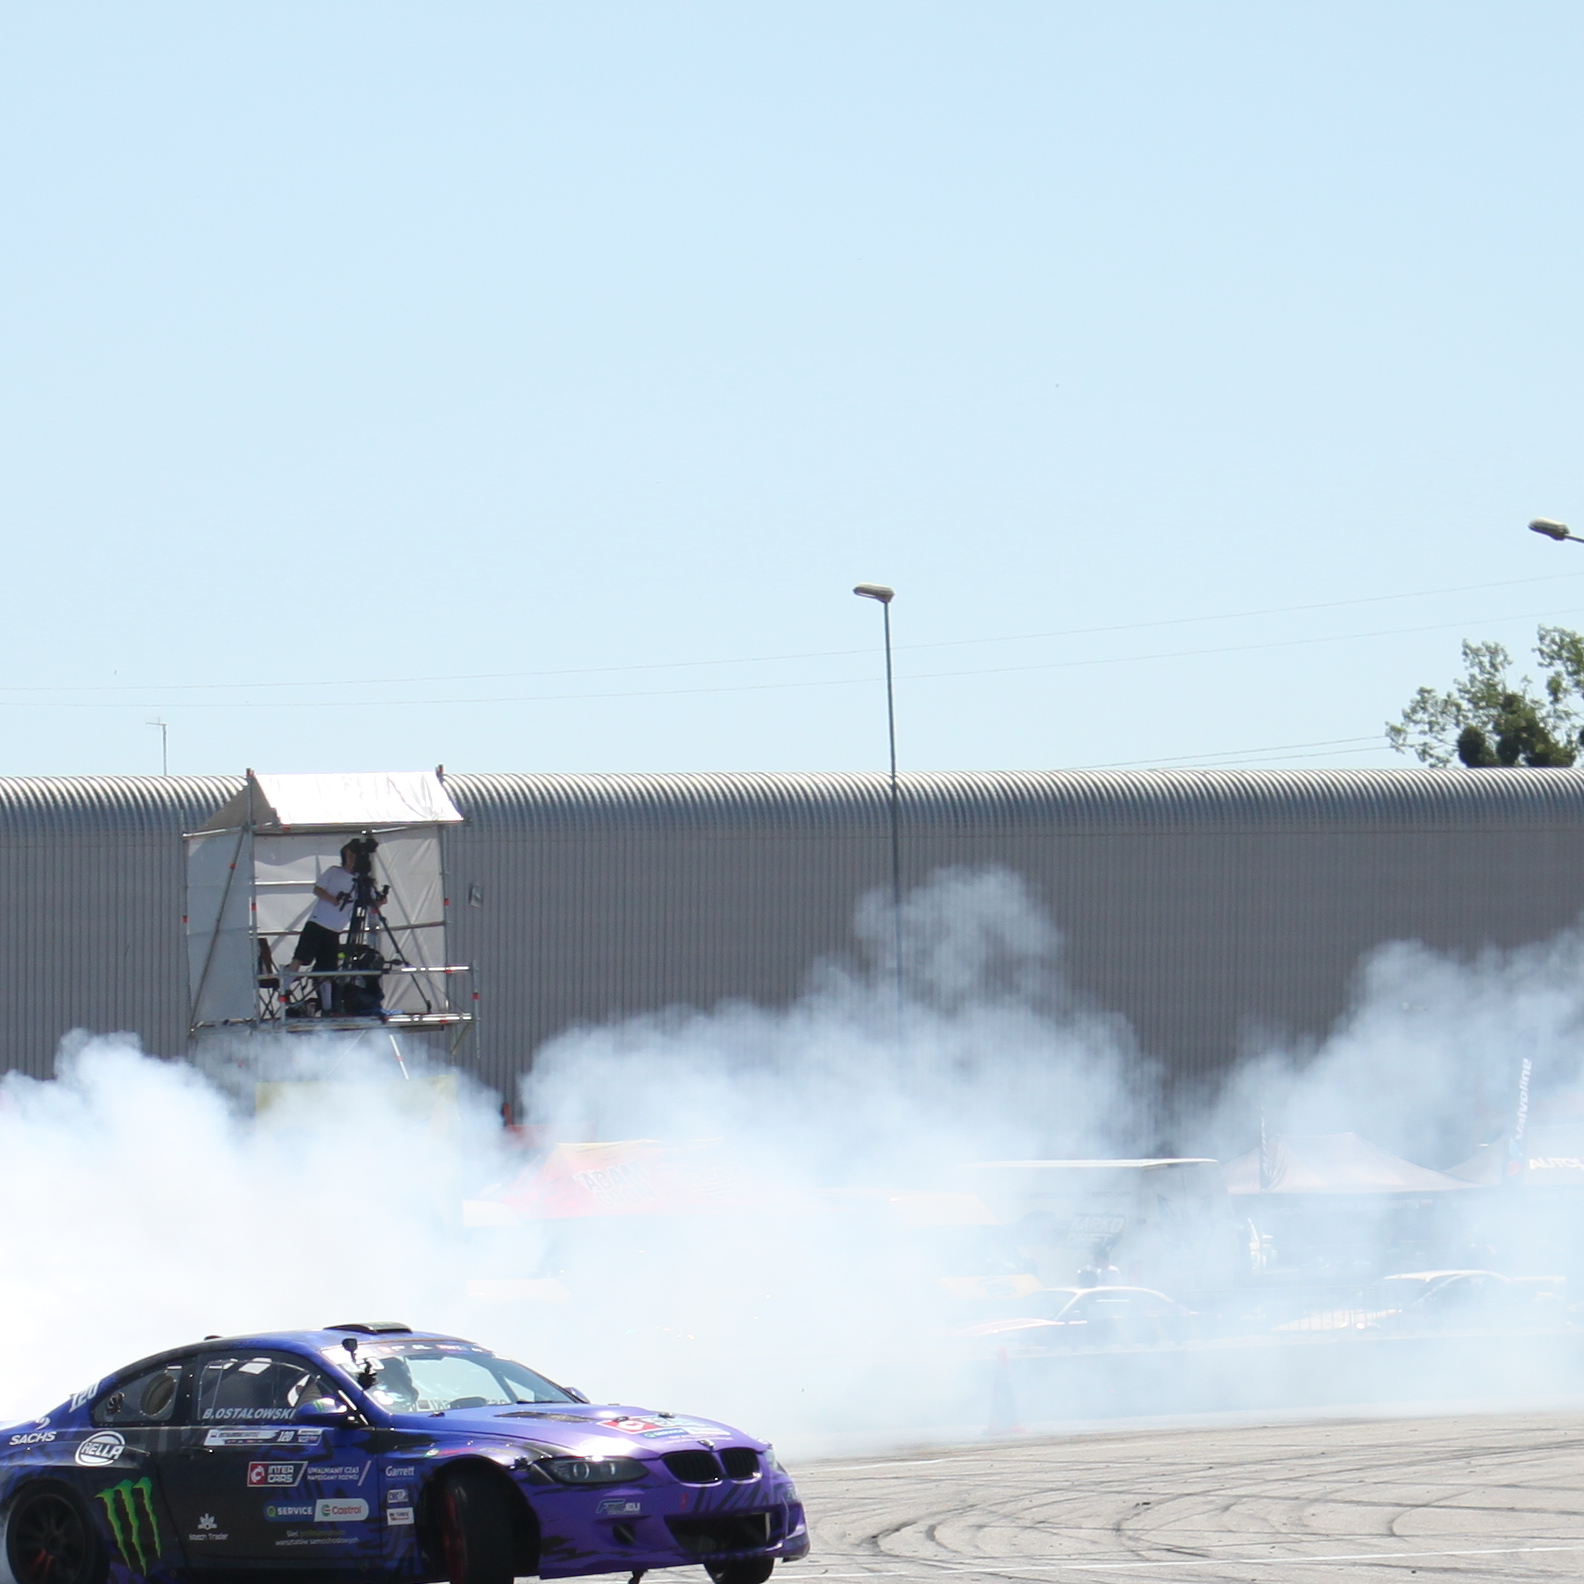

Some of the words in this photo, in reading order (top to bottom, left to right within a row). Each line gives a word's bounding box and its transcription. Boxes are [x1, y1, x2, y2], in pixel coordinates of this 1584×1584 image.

[9, 1431, 57, 1446] SACHS
[80, 1442, 125, 1460] HELLA
[267, 1465, 294, 1474] INTER
[385, 1465, 415, 1477] Garrett
[267, 1474, 293, 1483] CARS
[277, 1506, 313, 1516] SERVICE
[332, 1505, 362, 1516] Castrol
